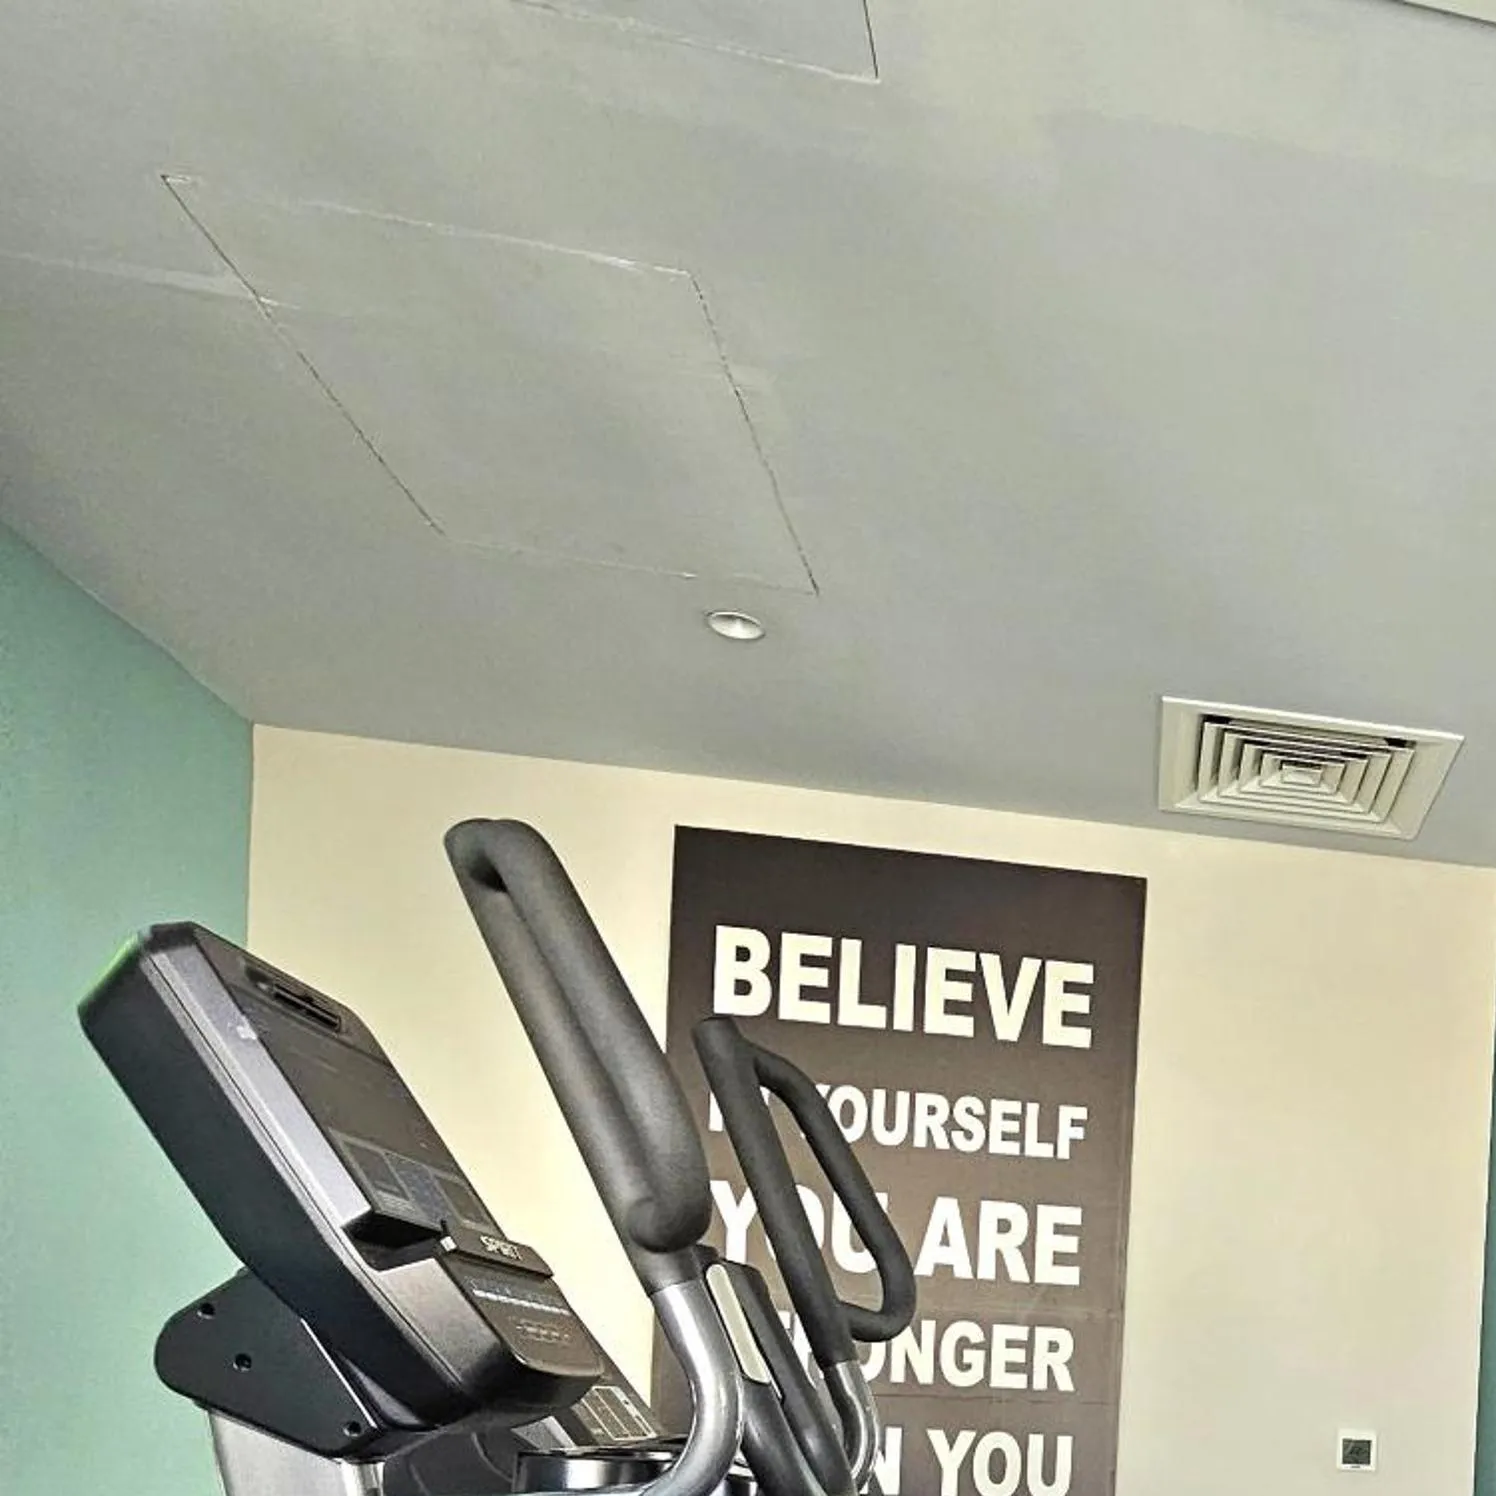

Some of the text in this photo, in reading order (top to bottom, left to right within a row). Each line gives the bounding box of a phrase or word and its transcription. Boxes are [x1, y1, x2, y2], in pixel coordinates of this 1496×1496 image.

[712, 925, 1094, 1048] BELIEVE
[806, 1083, 1088, 1160] OURSELF
[913, 1198, 1083, 1286] ARE
